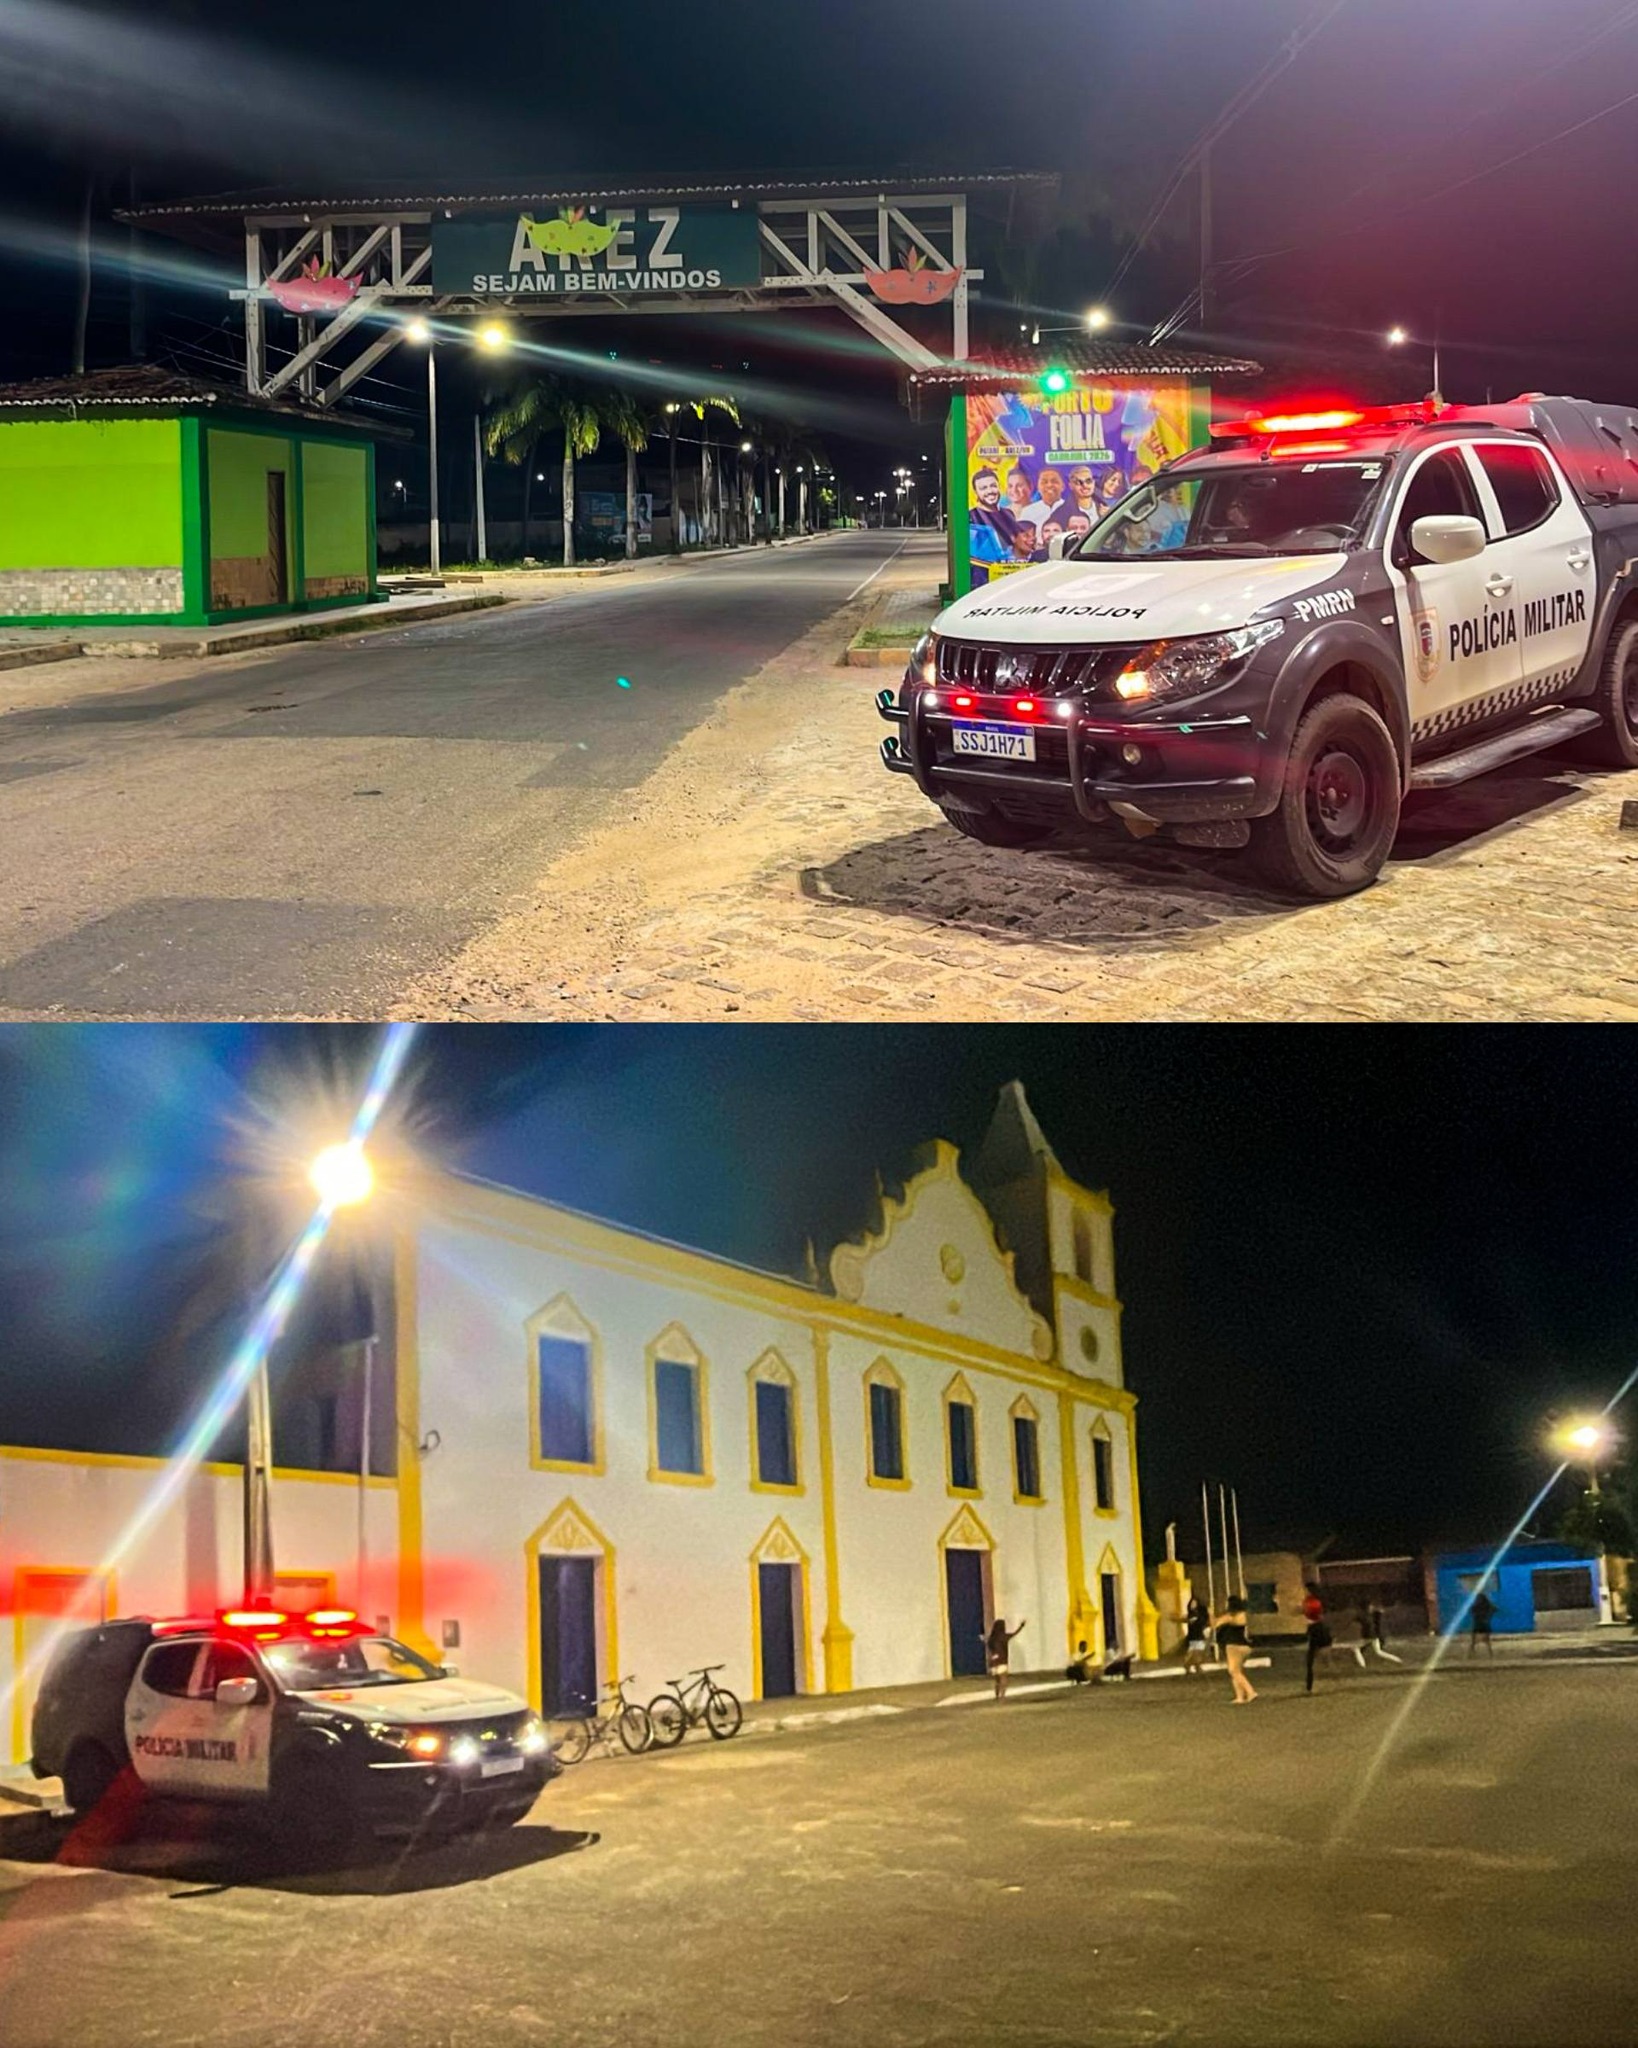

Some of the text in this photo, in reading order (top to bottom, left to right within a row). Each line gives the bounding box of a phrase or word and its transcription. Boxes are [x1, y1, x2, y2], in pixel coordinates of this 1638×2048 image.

[473, 270, 722, 293] SEJAM BEM-VINDOS
[1050, 414, 1105, 450] FOLIA
[1293, 588, 1355, 622] PMRN
[1449, 589, 1586, 661] POLÍCIA MILITAR
[961, 732, 1026, 756] SSJ1H71
